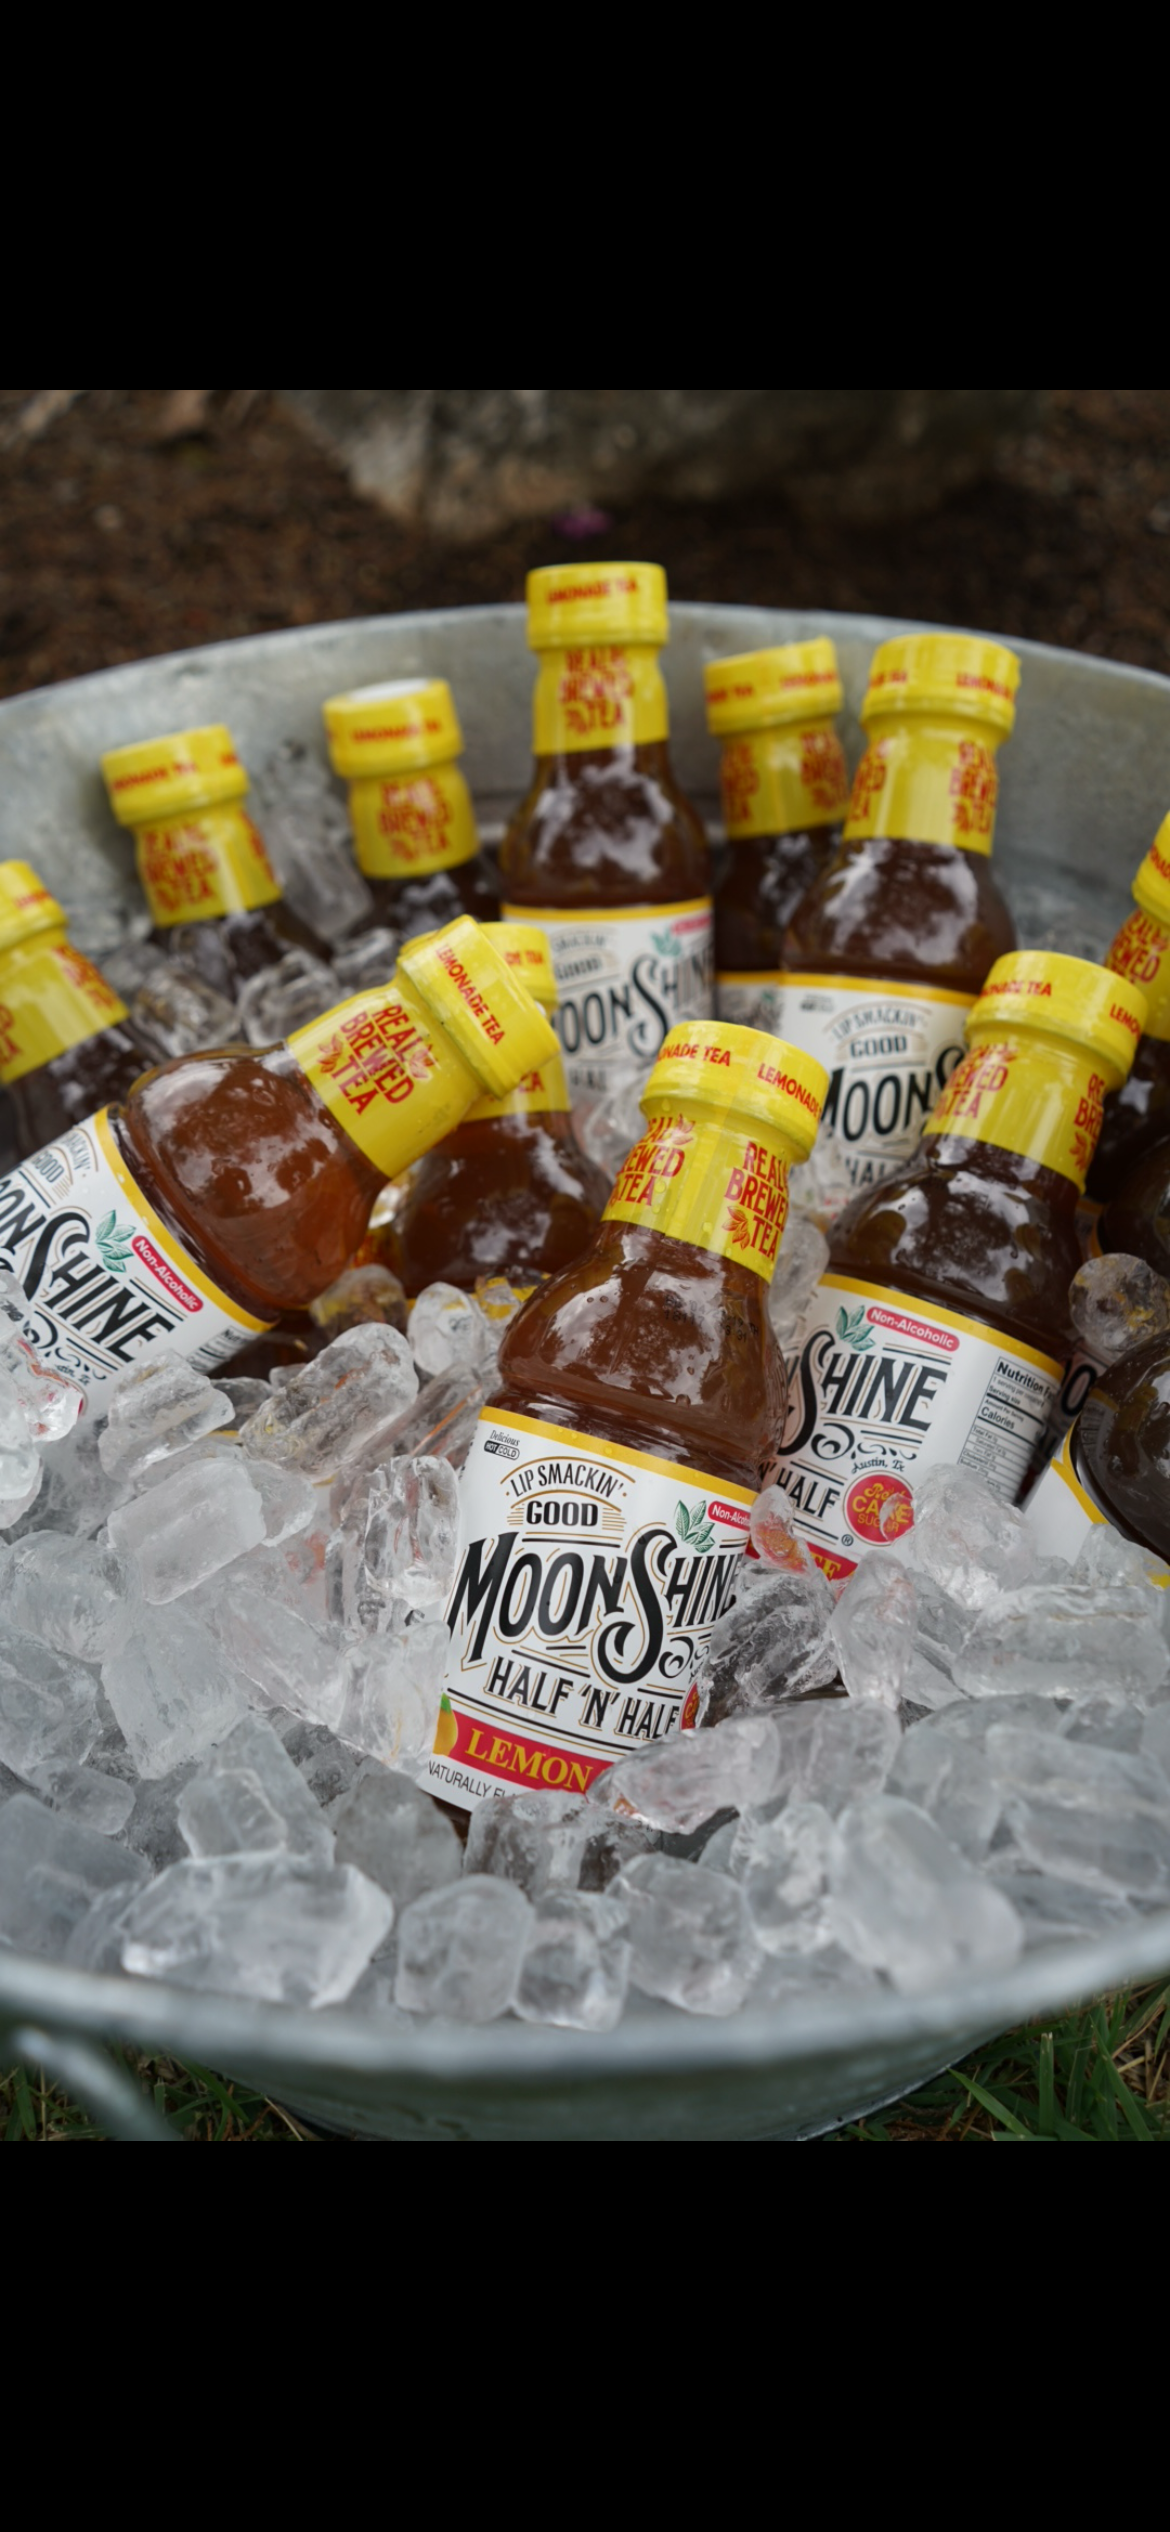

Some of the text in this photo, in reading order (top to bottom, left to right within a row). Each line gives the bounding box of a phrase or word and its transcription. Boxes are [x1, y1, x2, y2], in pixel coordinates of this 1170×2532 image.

[435, 943, 506, 1046] LEMONADE TEA
[1027, 982, 1051, 997] TEA
[371, 1004, 423, 1063] REAL
[1110, 1003, 1140, 1042] LEMO
[340, 1011, 415, 1104] BREWED
[703, 1047, 731, 1067] TEA
[851, 1035, 908, 1059] GOOD
[331, 1054, 379, 1117] TEA
[743, 1140, 784, 1193] REAL
[618, 1173, 658, 1206] TEA
[750, 1215, 779, 1262] TEA
[0, 1179, 175, 1363] ONSHINE
[135, 1239, 198, 1310] Non-Alcoholic
[870, 1309, 954, 1349] Non-Alcoholic
[997, 1361, 1043, 1394] Nutrition
[981, 1406, 1015, 1430] Calories
[498, 1446, 518, 1458] COLD
[852, 1458, 888, 1474] Austin,
[510, 1463, 624, 1498] LIP SMACKIN'
[526, 1500, 599, 1527] GOOD
[487, 1656, 573, 1714] HALF
[465, 1728, 594, 1792] LEMON
